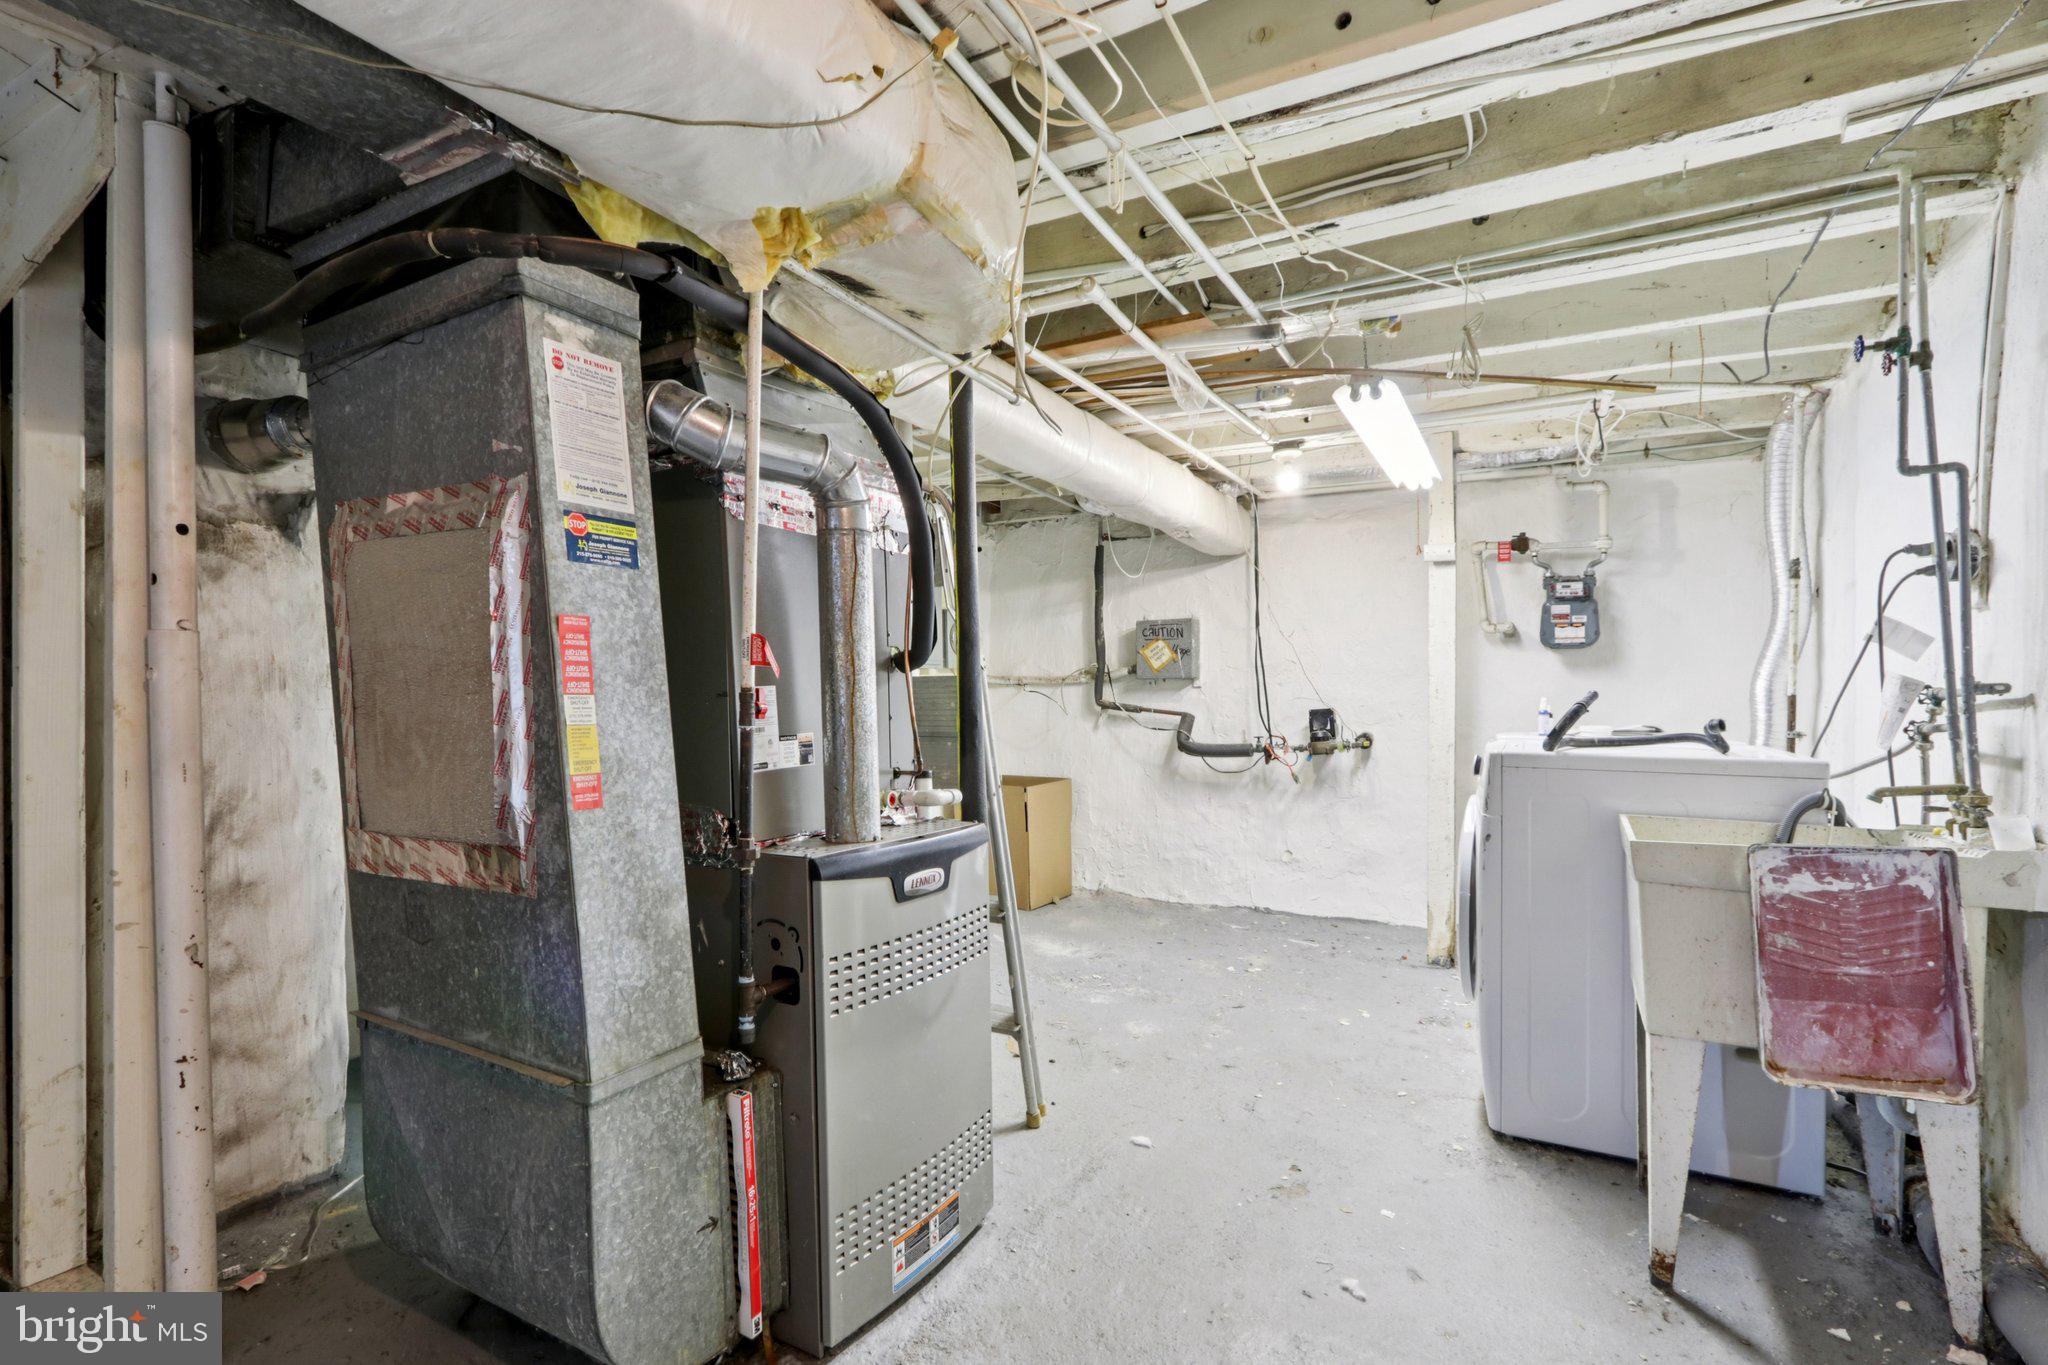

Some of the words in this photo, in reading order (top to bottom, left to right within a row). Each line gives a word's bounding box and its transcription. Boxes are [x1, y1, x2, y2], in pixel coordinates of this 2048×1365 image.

[552, 348, 563, 356] DO
[565, 352, 580, 362] NOT
[583, 359, 614, 372] REMOVE
[576, 483, 598, 493] Joseph
[599, 488, 628, 498] Giannone
[568, 521, 587, 530] STOP
[1141, 627, 1184, 638] CAUTION
[911, 874, 936, 889] LENNOX
